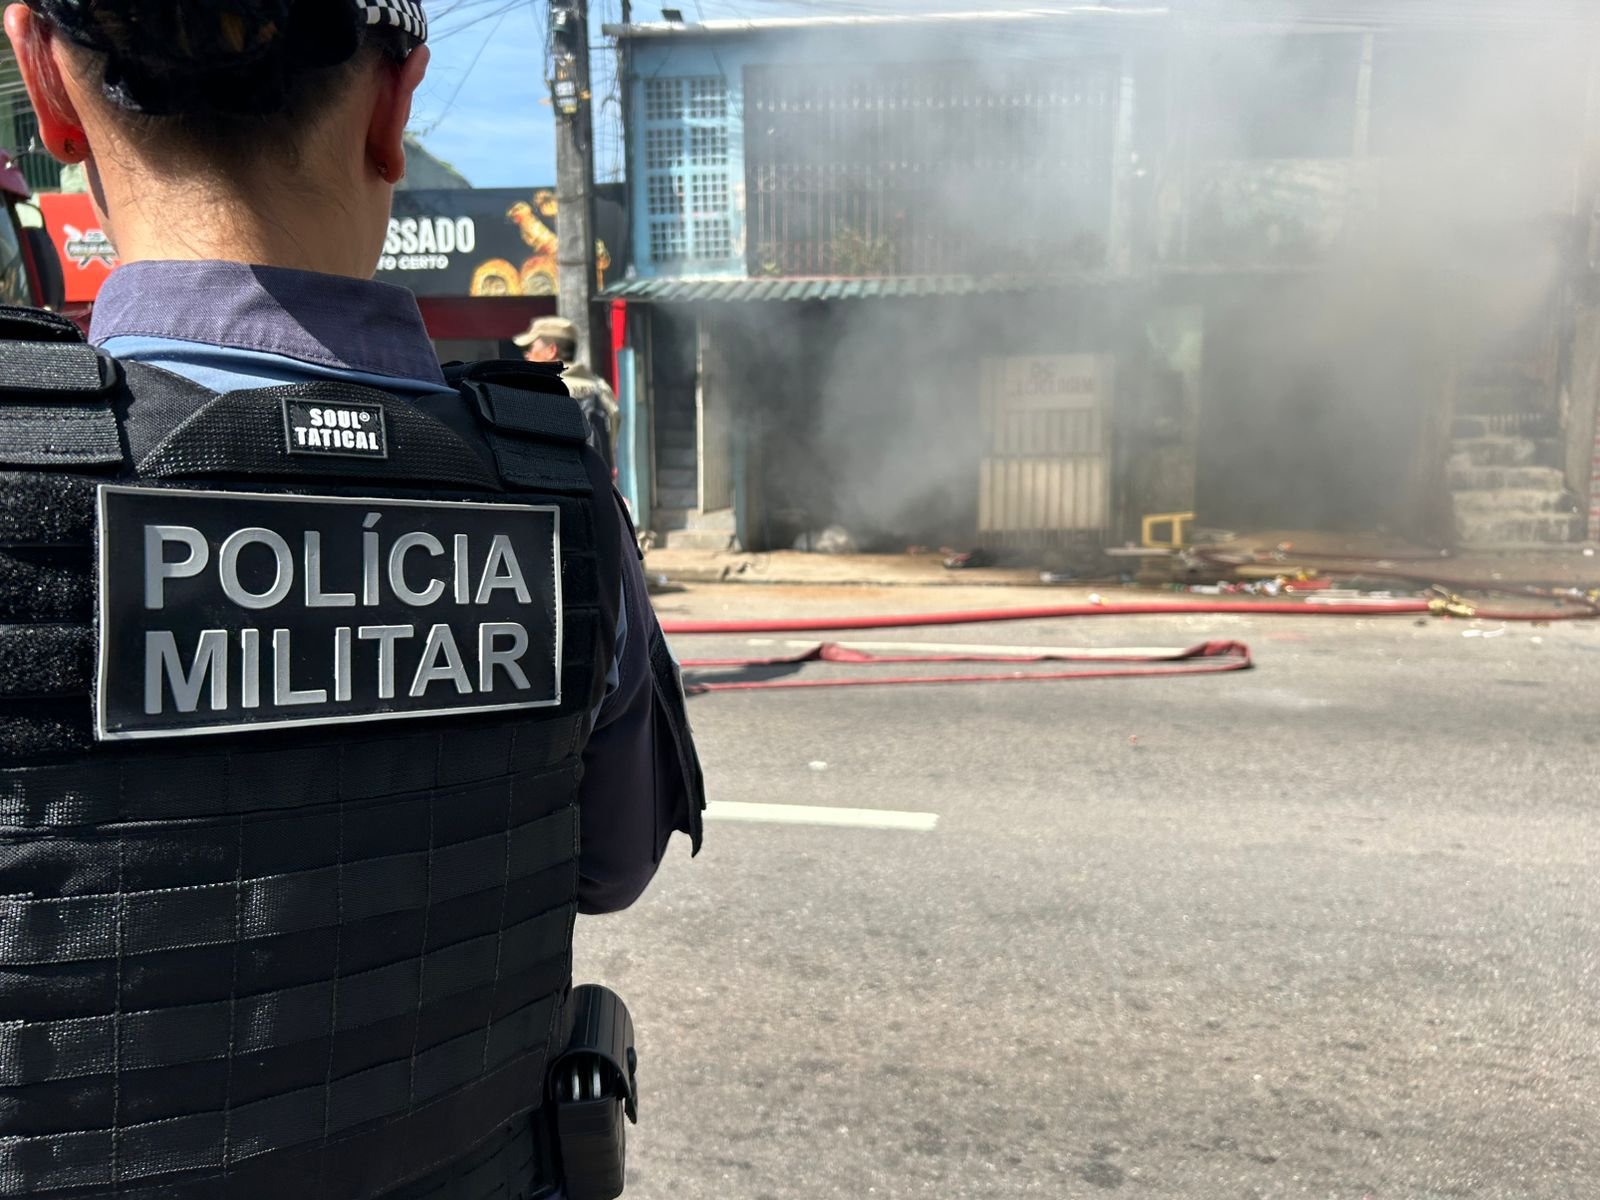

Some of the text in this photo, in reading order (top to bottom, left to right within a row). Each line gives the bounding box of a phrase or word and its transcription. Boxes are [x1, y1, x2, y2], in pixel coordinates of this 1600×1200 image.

[382, 216, 475, 255] SSADO
[398, 254, 449, 271] CERTO
[294, 426, 379, 450] TATICAL
[143, 512, 532, 610] POLÍCIA
[143, 622, 531, 715] MILITAR
